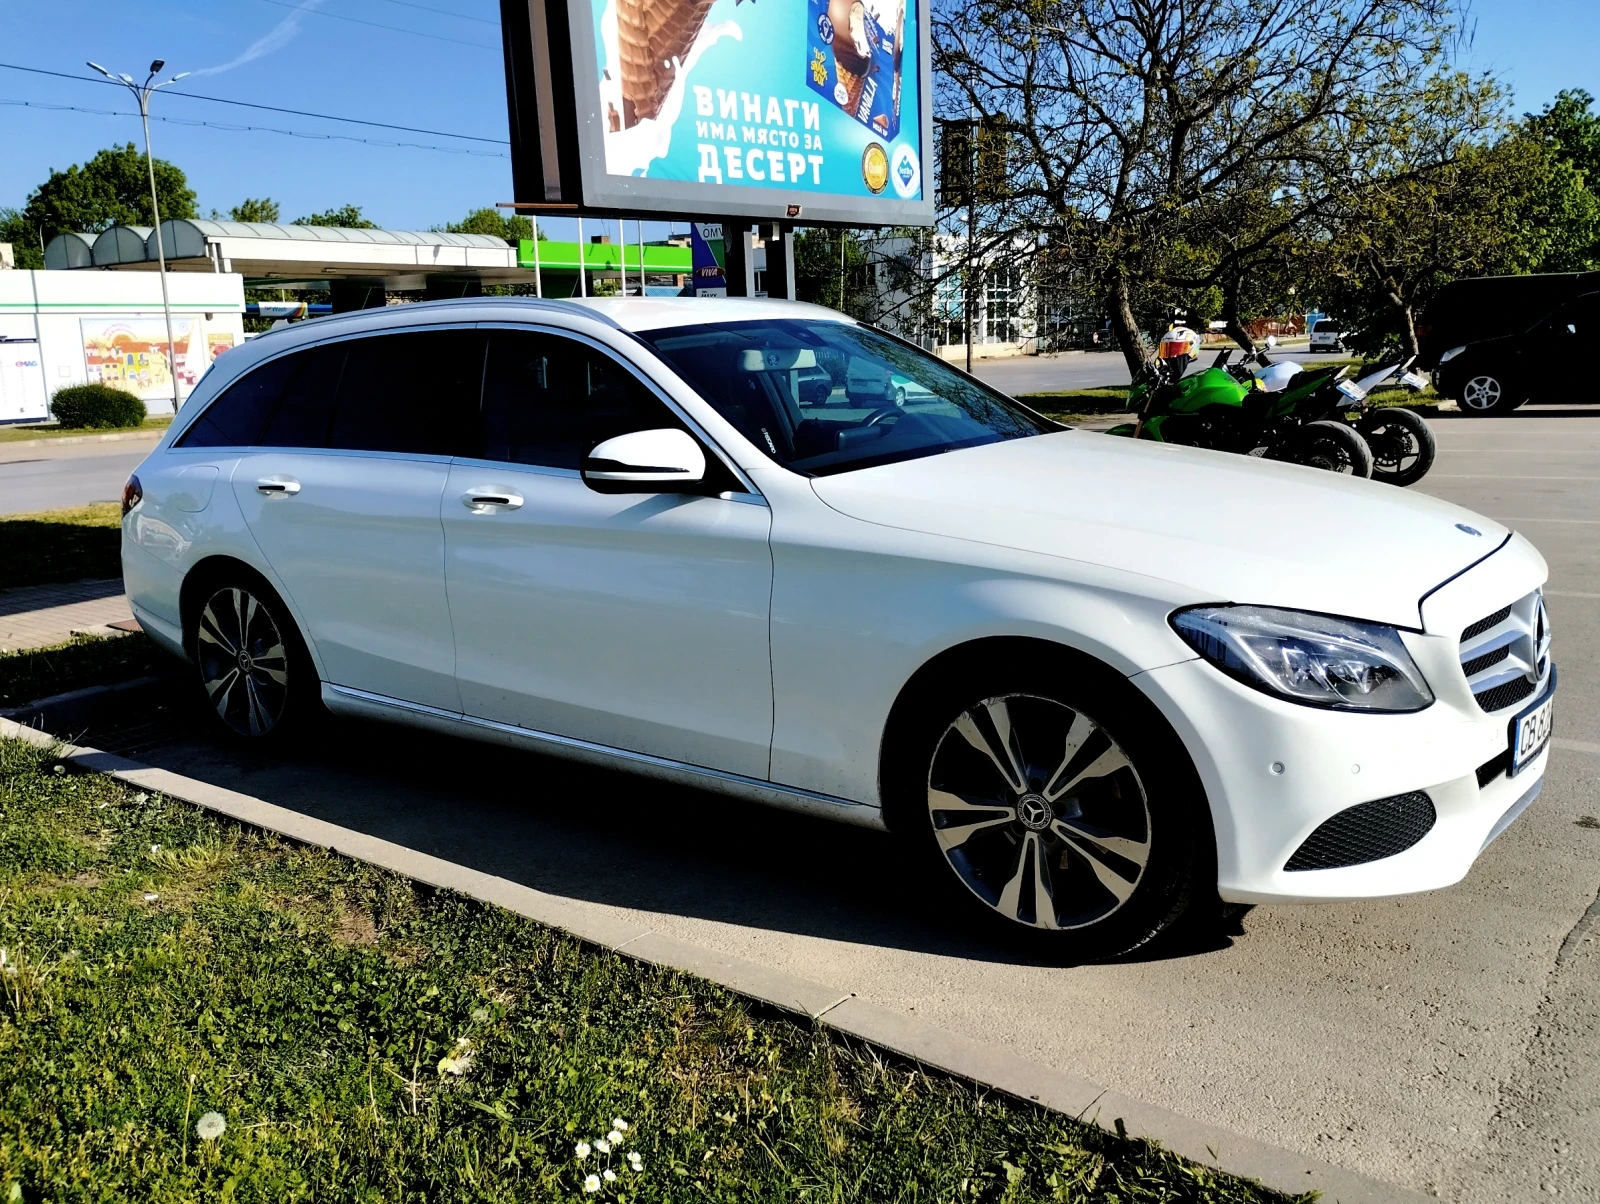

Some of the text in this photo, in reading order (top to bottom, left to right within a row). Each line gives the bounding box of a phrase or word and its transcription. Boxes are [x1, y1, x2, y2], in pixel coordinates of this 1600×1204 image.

[693, 85, 820, 130] ВИНАГИ
[695, 120, 823, 151] ИМА МЯСТО ЗА
[697, 143, 824, 185] ДЕСЕРТ
[701, 269, 718, 277] VIVA
